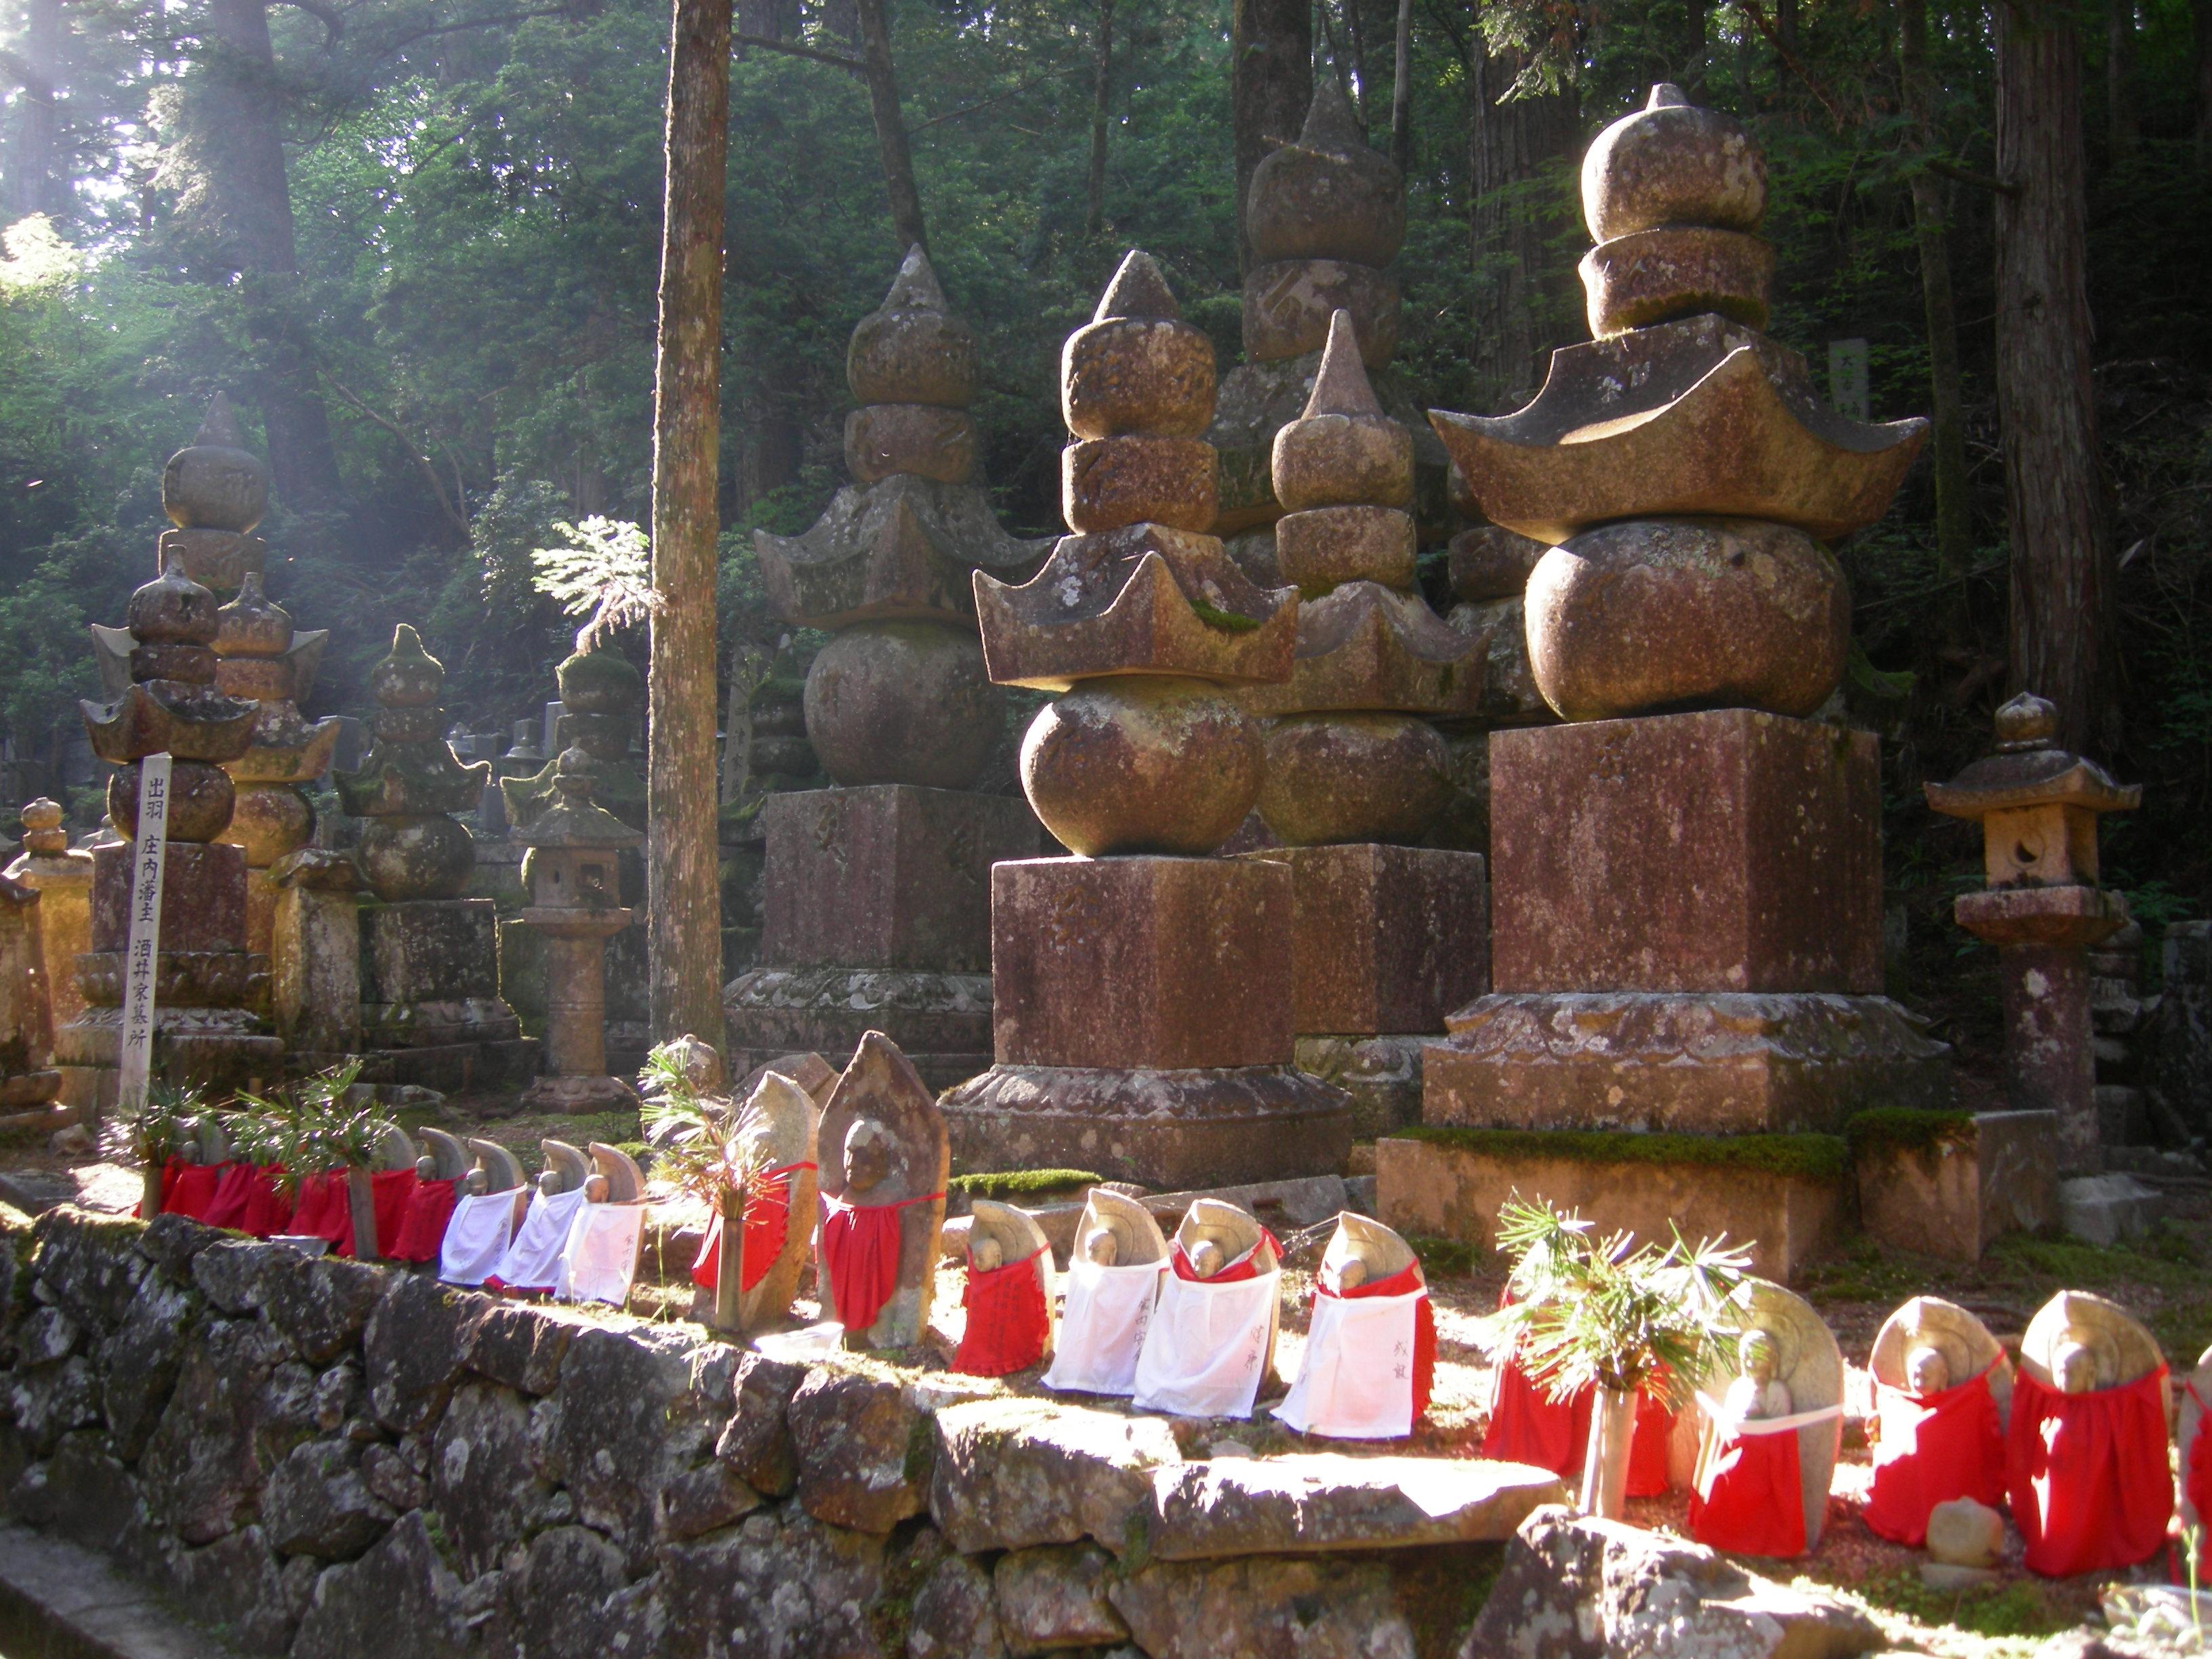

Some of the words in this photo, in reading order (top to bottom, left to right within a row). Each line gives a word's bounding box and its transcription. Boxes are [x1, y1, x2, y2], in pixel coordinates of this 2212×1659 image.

[146, 777, 164, 819] 出羽
[138, 834, 161, 922] 庄内藩主
[126, 939, 152, 1050] 酒井家墓所
